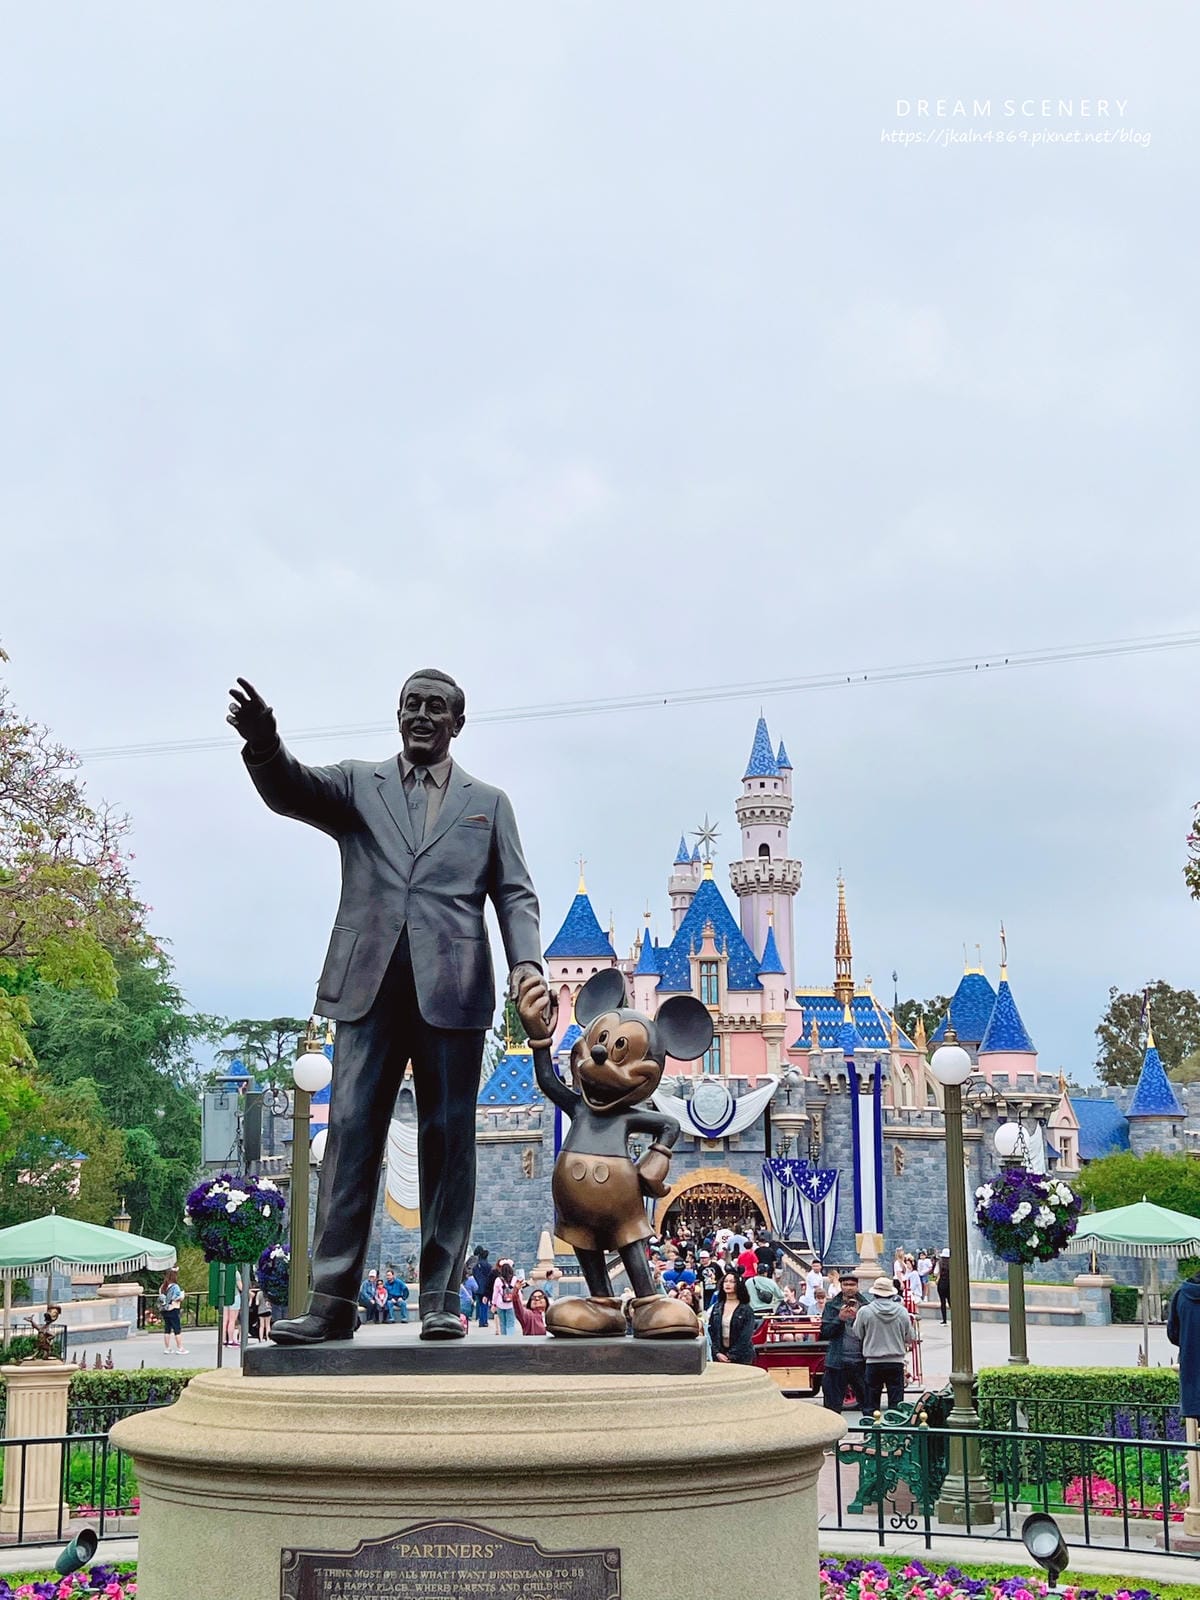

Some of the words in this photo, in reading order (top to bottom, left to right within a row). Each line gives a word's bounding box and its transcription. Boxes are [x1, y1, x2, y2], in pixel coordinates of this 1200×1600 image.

[323, 1568, 352, 1578] THINK
[354, 1569, 381, 1579] MOST
[399, 1570, 418, 1580] ALL
[420, 1570, 448, 1580] WHAT
[458, 1570, 487, 1579] WANT
[489, 1569, 553, 1579] DISNEYLAND
[555, 1569, 569, 1578] TO
[334, 1581, 342, 1590] A
[344, 1581, 375, 1591] HAPPY
[415, 1583, 450, 1593] WHERE
[452, 1583, 496, 1593] PARENTS
[500, 1582, 520, 1592] AND
[523, 1581, 573, 1592] CHILDREN
